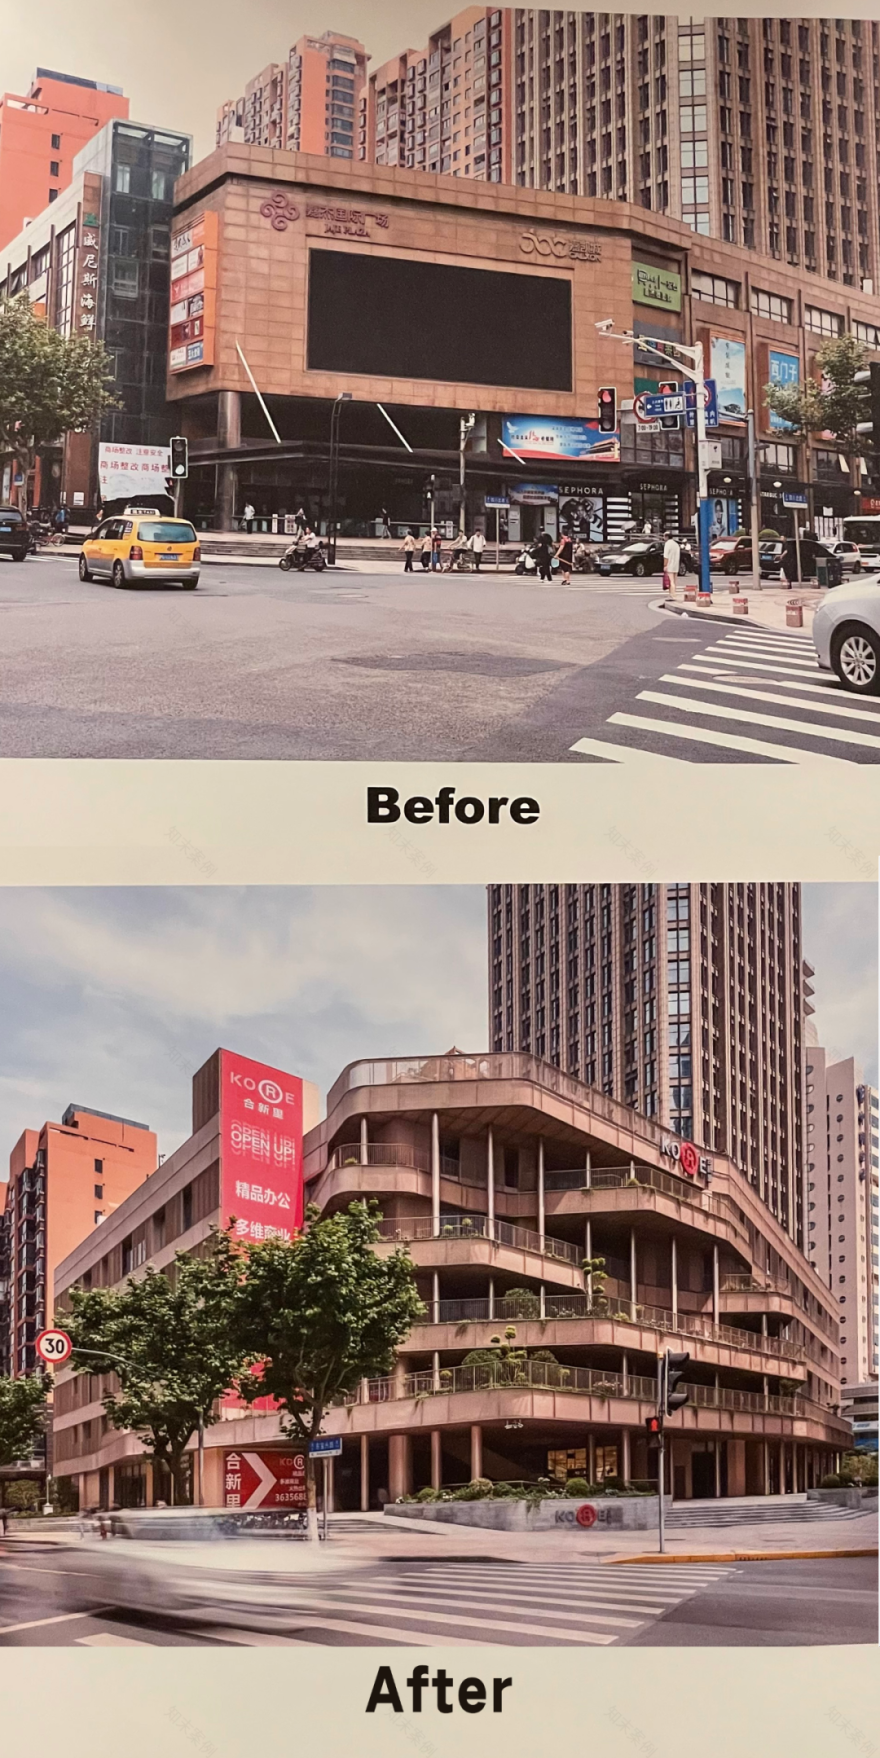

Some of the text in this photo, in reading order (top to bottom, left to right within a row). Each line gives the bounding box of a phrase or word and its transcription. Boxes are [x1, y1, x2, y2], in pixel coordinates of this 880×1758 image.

[770, 359, 797, 381] 西门子
[105, 446, 132, 455] 商场整改
[558, 486, 604, 495] SEPHORA
[640, 483, 668, 491] SEPHORA
[709, 488, 733, 496] SEPHOA
[243, 1098, 284, 1120] 合新里
[231, 1130, 270, 1153] OPEN
[235, 1180, 291, 1210] 精品办公
[44, 1338, 65, 1354] 30
[225, 1452, 242, 1508] 合新里
